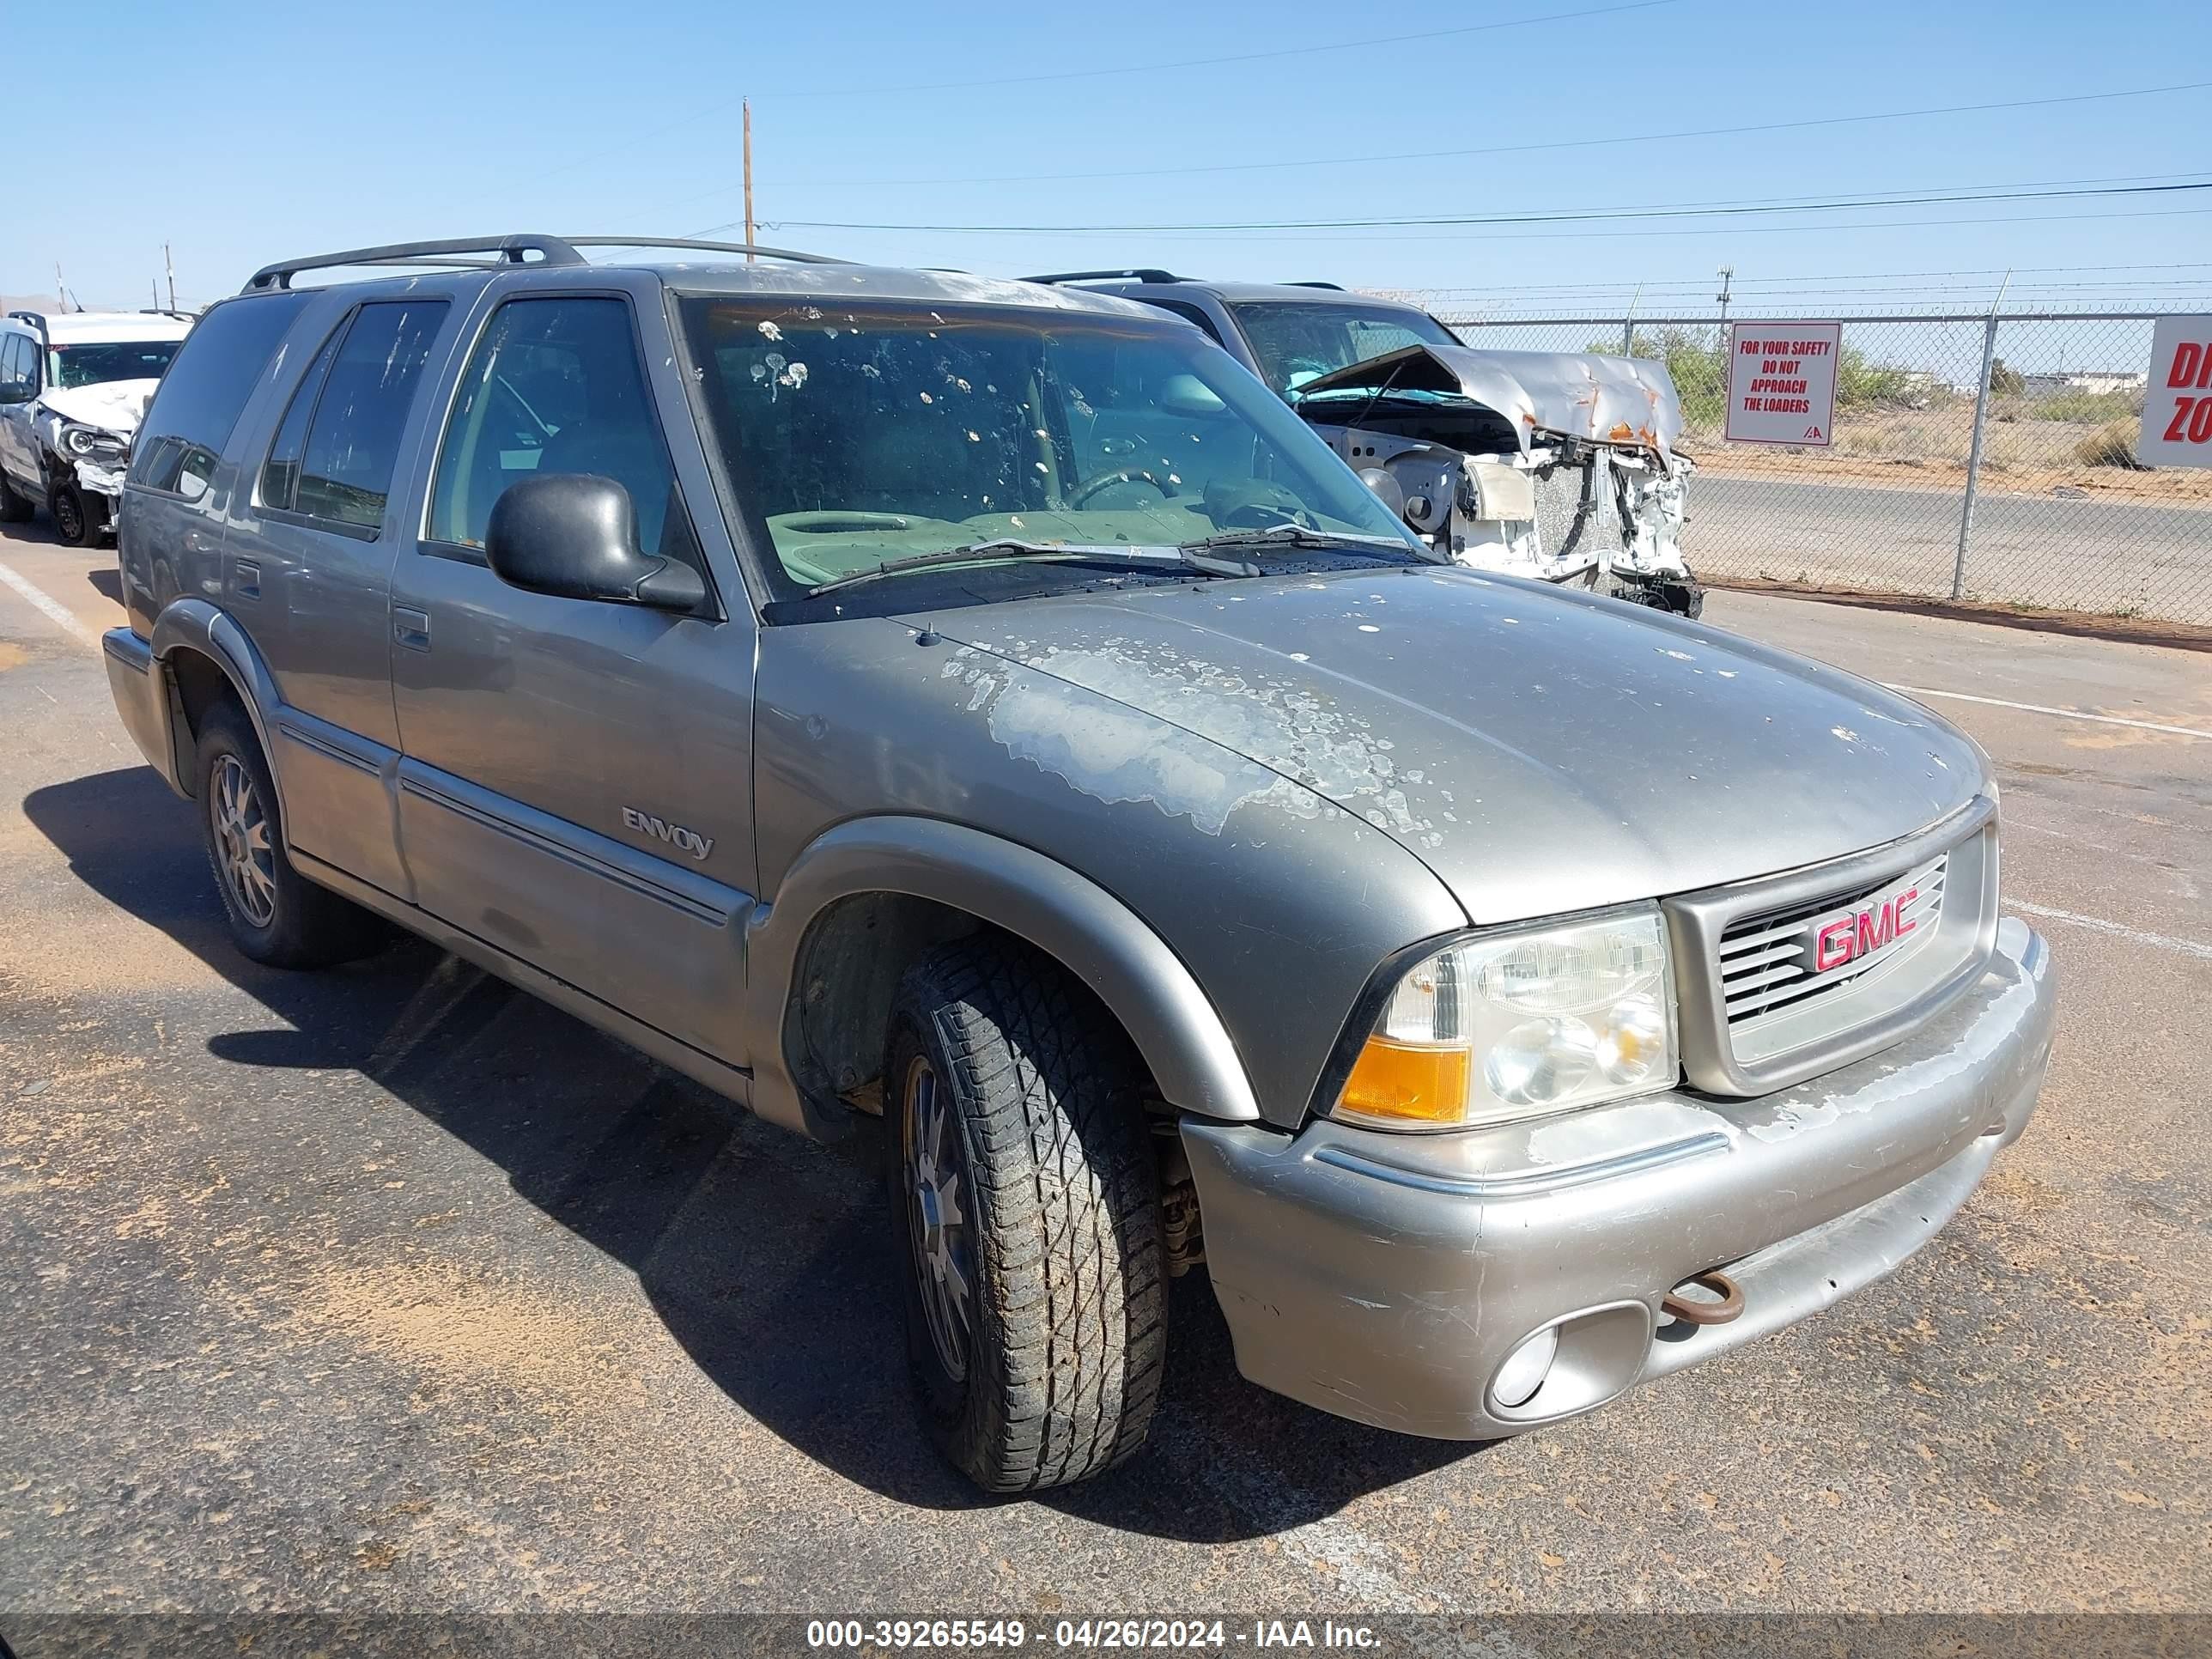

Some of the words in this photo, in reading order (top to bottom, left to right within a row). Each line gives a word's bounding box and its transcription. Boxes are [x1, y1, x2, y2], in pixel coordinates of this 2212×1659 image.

[1740, 341, 1759, 355] FOR
[1762, 341, 1790, 356] YOUR
[1791, 342, 1831, 356] SAFETY
[1762, 360, 1776, 374] DO
[1778, 361, 1801, 374] NOT
[1750, 379, 1808, 394] APPROACH
[1744, 398, 1762, 411] THE
[1763, 398, 1810, 413] LOADERS
[622, 805, 714, 860] ENVOY
[1814, 886, 1918, 973] GMC
